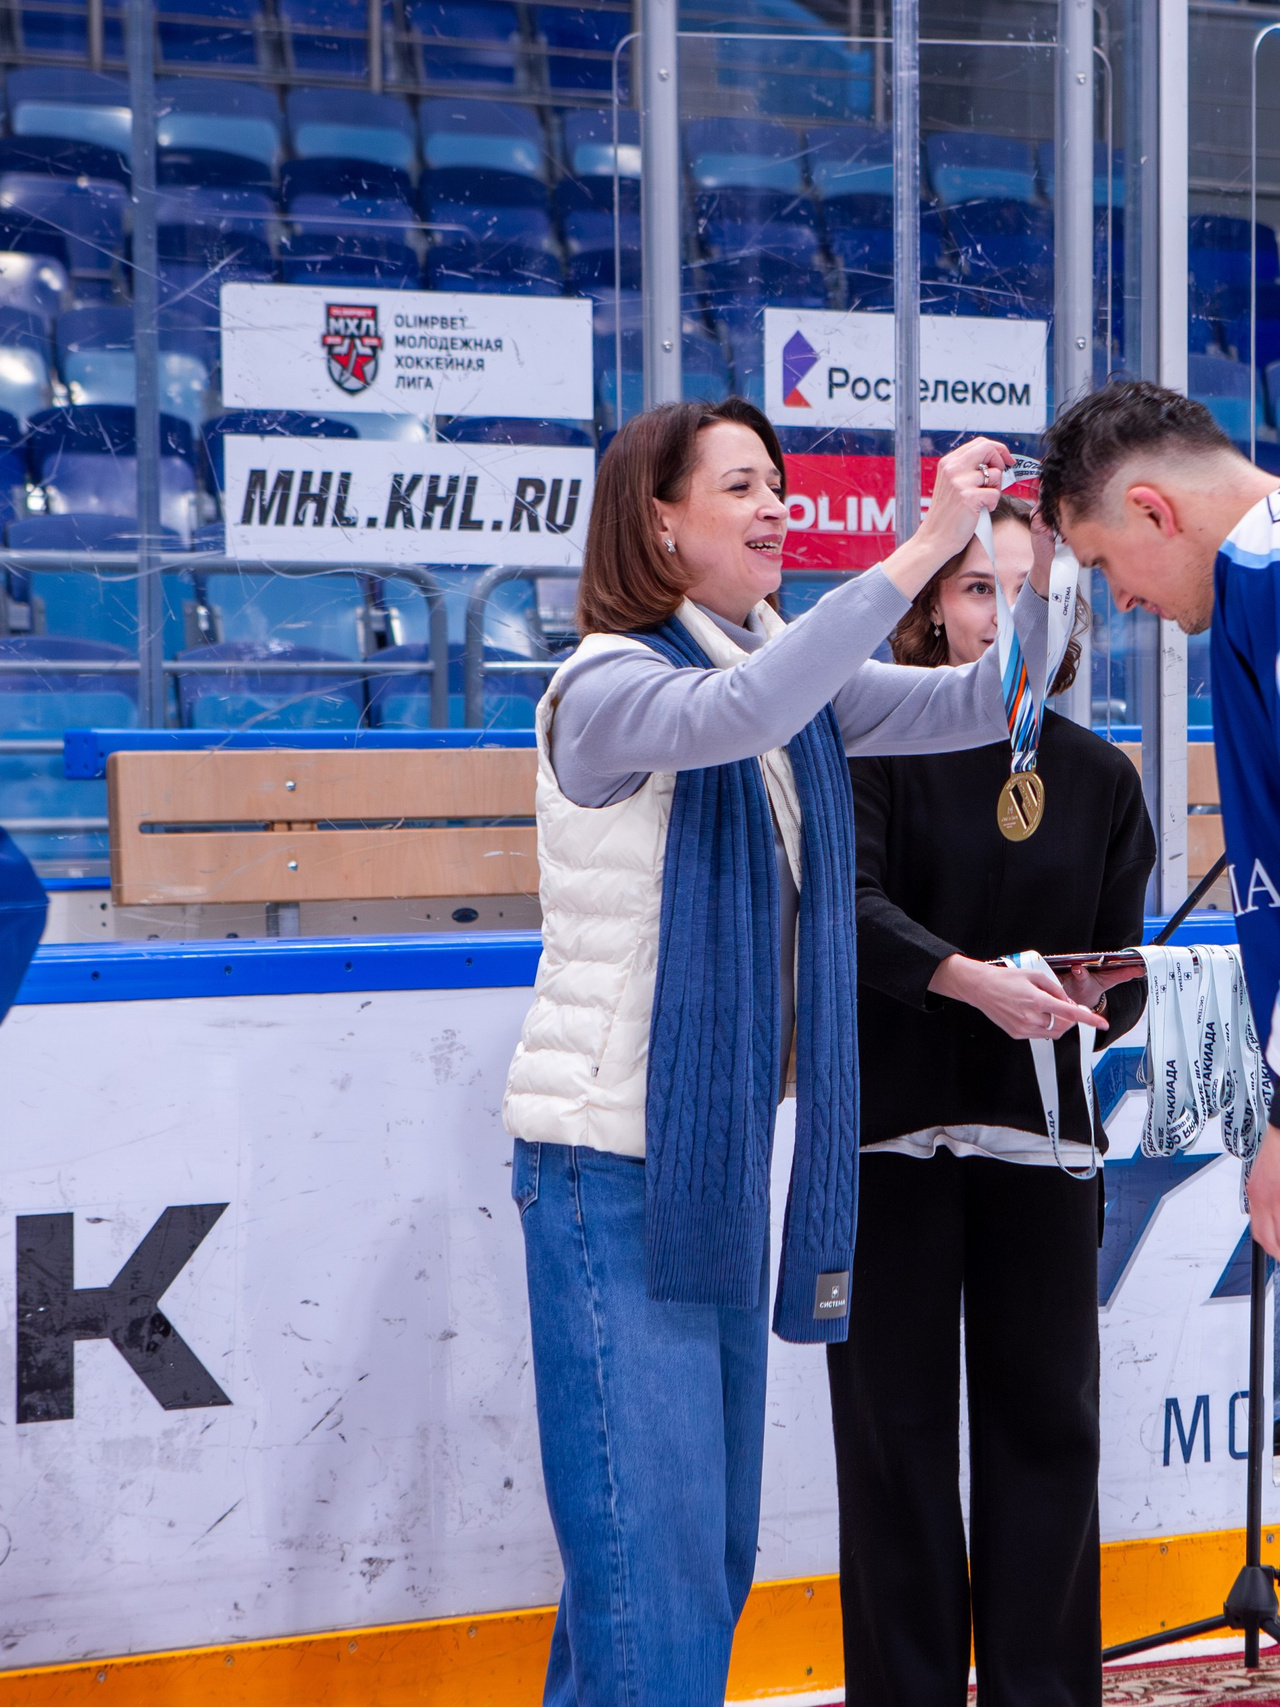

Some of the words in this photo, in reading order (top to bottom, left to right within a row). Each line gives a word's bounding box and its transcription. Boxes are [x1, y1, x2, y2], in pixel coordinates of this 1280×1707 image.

[329, 317, 376, 336] МХЛ
[394, 314, 468, 331] OLIMPBET
[394, 335, 504, 352] МОЛОДЕЖНАЯ
[394, 354, 486, 372] ХОККЕЙНАЯ
[395, 375, 434, 391] ЛИГА
[827, 366, 1031, 406] Роселеком
[240, 468, 582, 534] MHL.KHL.RU
[786, 494, 931, 532] OLIM
[1062, 586, 1072, 617] СИСТЕМА
[1176, 961, 1184, 992] СИСТЕМА
[1153, 975, 1161, 1006] СИСТЕМА
[819, 1298, 846, 1309] СИСТЕМА
